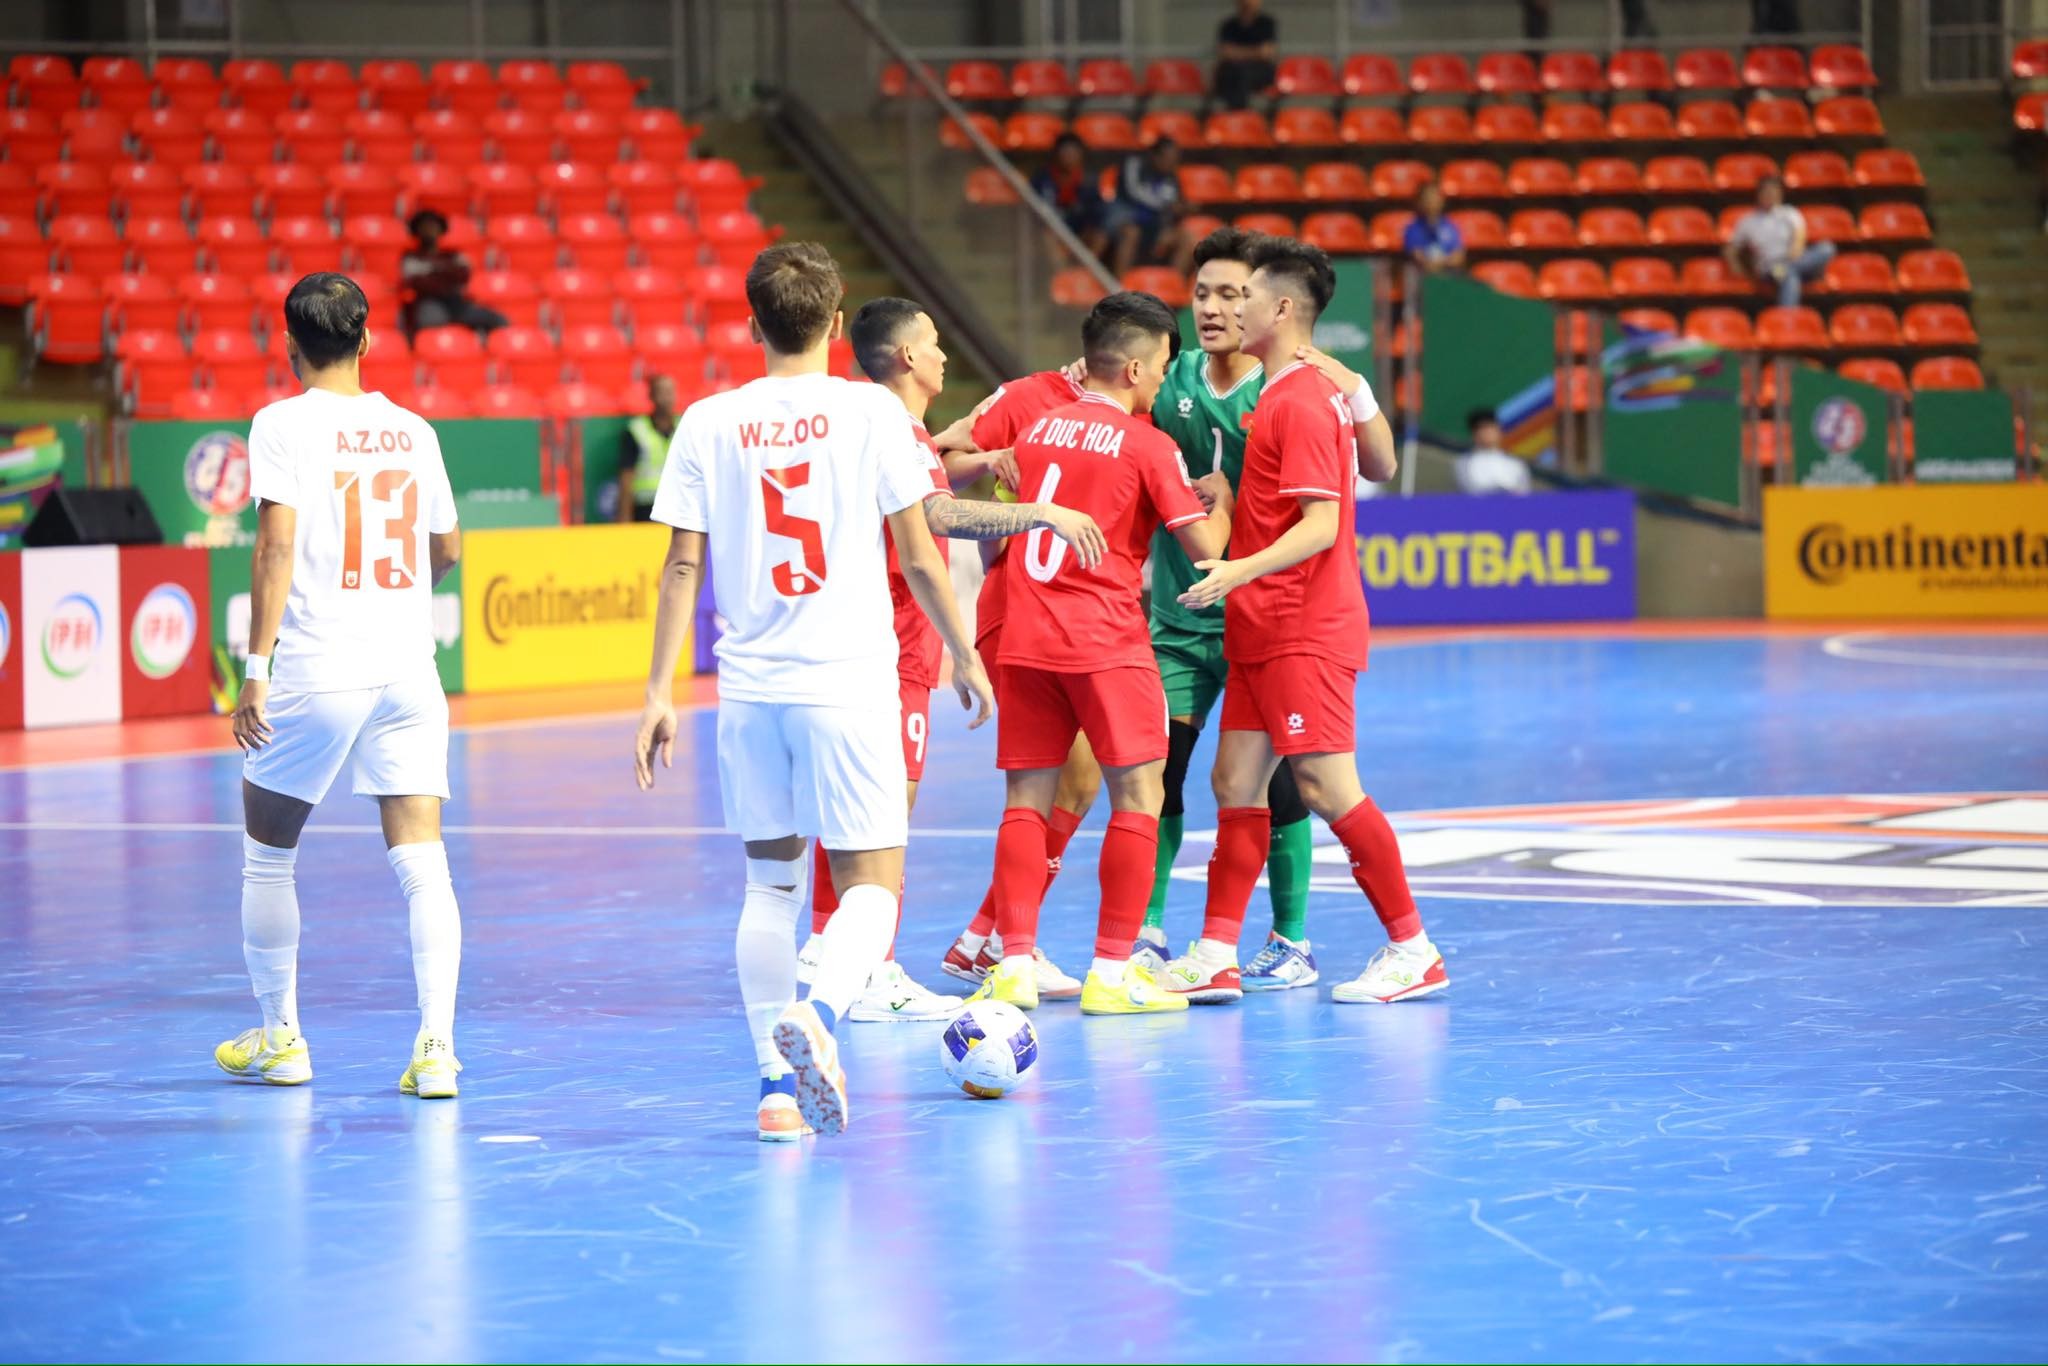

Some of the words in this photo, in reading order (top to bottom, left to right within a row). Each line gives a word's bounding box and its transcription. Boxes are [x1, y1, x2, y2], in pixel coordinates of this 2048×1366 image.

[337, 430, 413, 453] A.Z.OO
[739, 414, 829, 449] W.Z.OO
[1027, 417, 1047, 444] P.
[1042, 418, 1084, 450] DUC
[1081, 421, 1126, 459] HOA
[334, 469, 418, 590] 13
[760, 461, 827, 597] 5
[1024, 462, 1069, 584] 6
[1797, 521, 2048, 588] Continenta
[482, 571, 648, 645] Continental
[907, 712, 926, 764] 9
